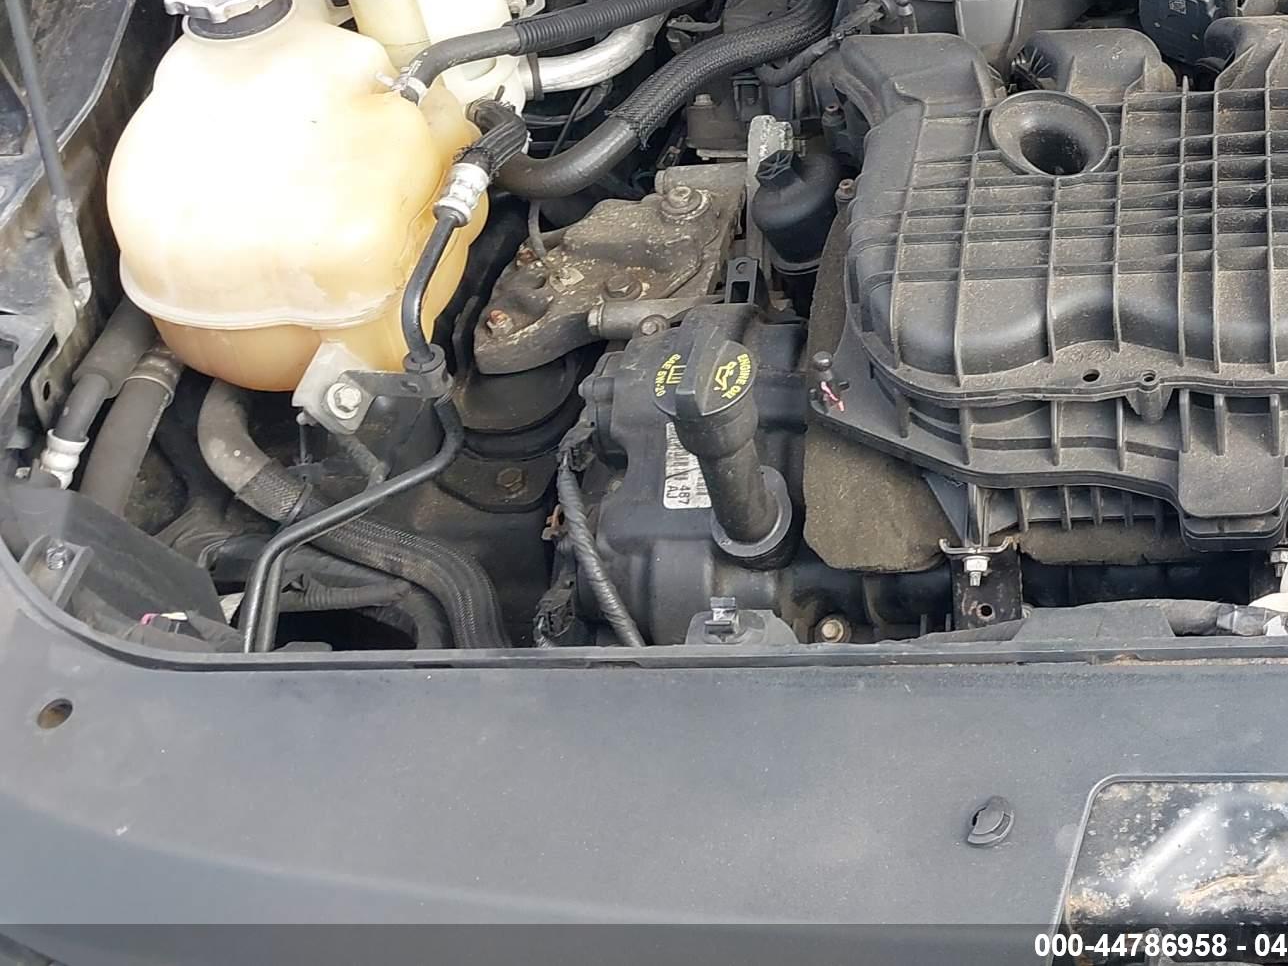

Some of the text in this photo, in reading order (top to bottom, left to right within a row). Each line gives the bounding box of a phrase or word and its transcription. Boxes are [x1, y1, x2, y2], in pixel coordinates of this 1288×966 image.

[661, 354, 682, 371] SAE
[721, 353, 752, 400] ENGINE OIL
